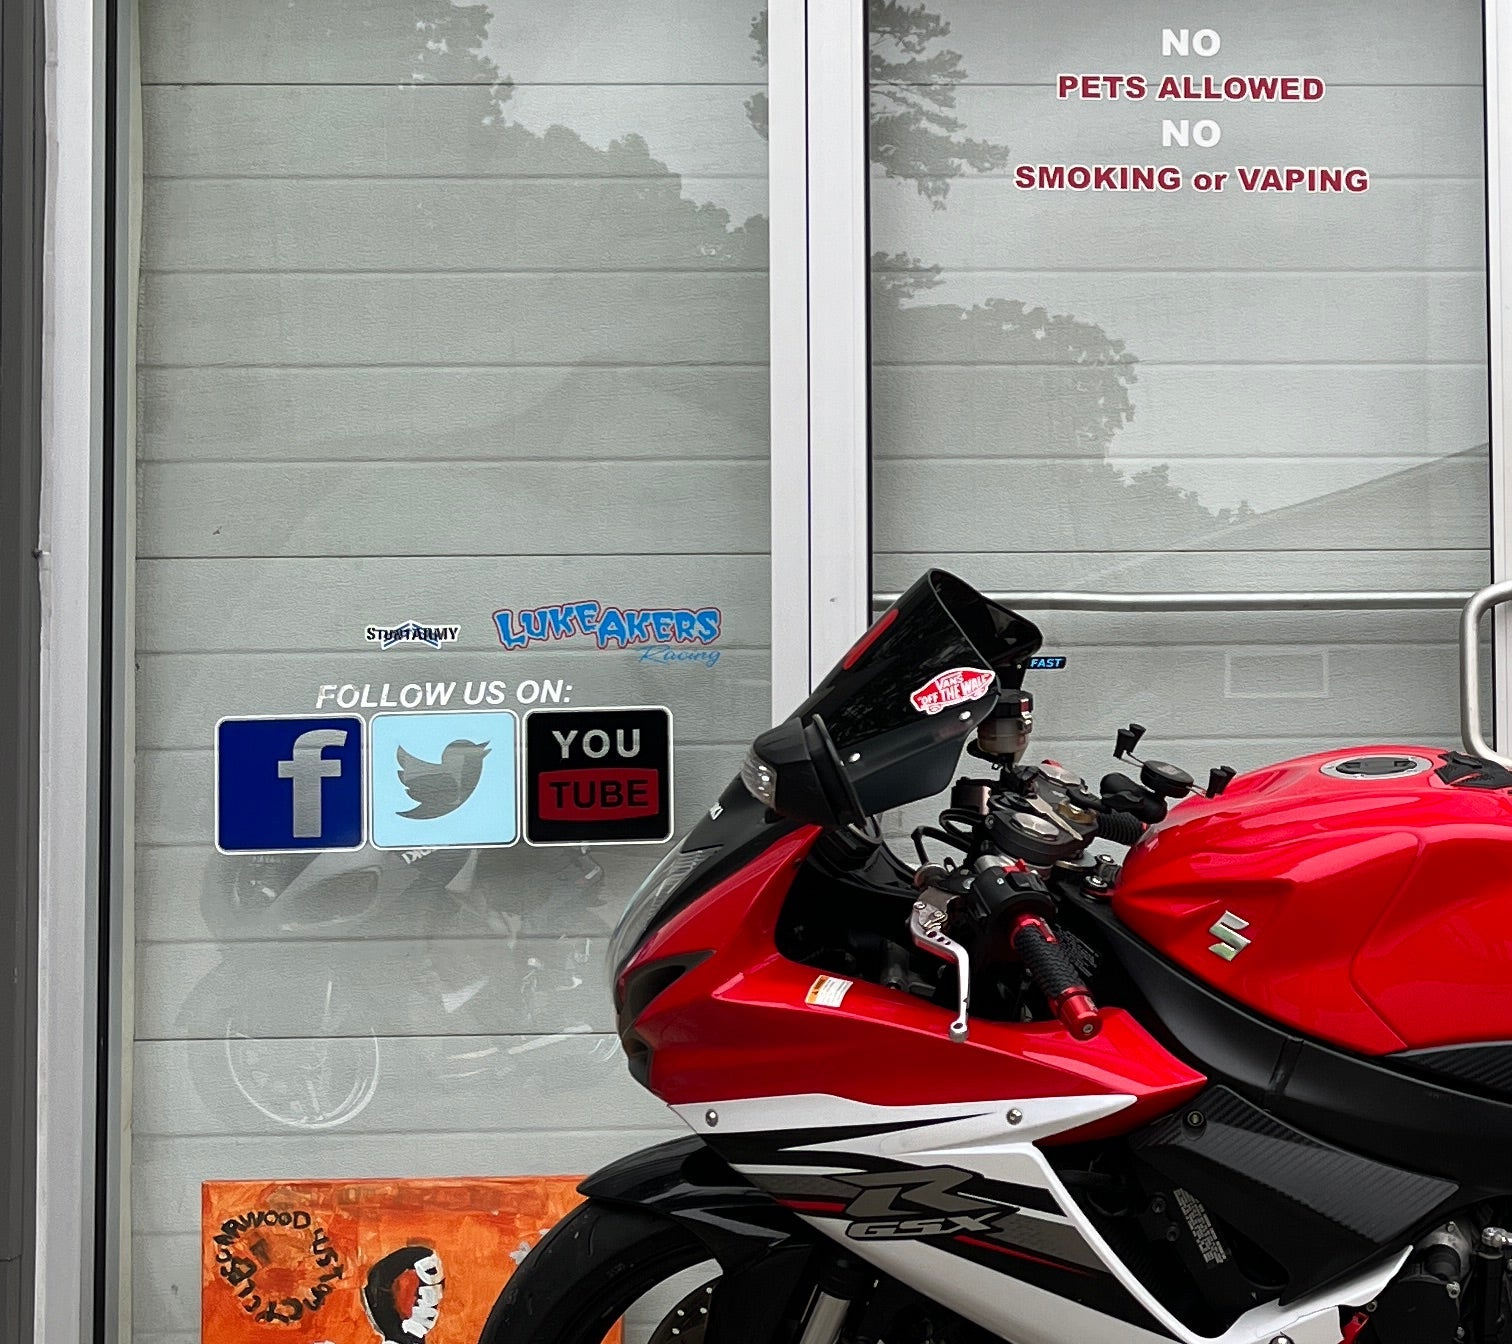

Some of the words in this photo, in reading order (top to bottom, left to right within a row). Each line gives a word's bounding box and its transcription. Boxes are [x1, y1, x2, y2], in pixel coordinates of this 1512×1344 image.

[1162, 29, 1221, 57] NO
[1058, 75, 1146, 99] PETS
[1158, 76, 1325, 101] ALLOWED
[1162, 119, 1221, 147] NO
[1015, 166, 1181, 190] SMOKING
[1193, 172, 1227, 191] or
[1238, 168, 1369, 193] VAPING
[639, 645, 722, 667] Racing
[1030, 658, 1062, 667] FAST
[315, 682, 456, 708] FOLLOW
[464, 681, 507, 705] US
[516, 679, 574, 704] ON:
[935, 672, 963, 689] VANS
[939, 684, 962, 702] THE
[552, 728, 641, 759] YOU
[549, 779, 649, 809] TUBE
